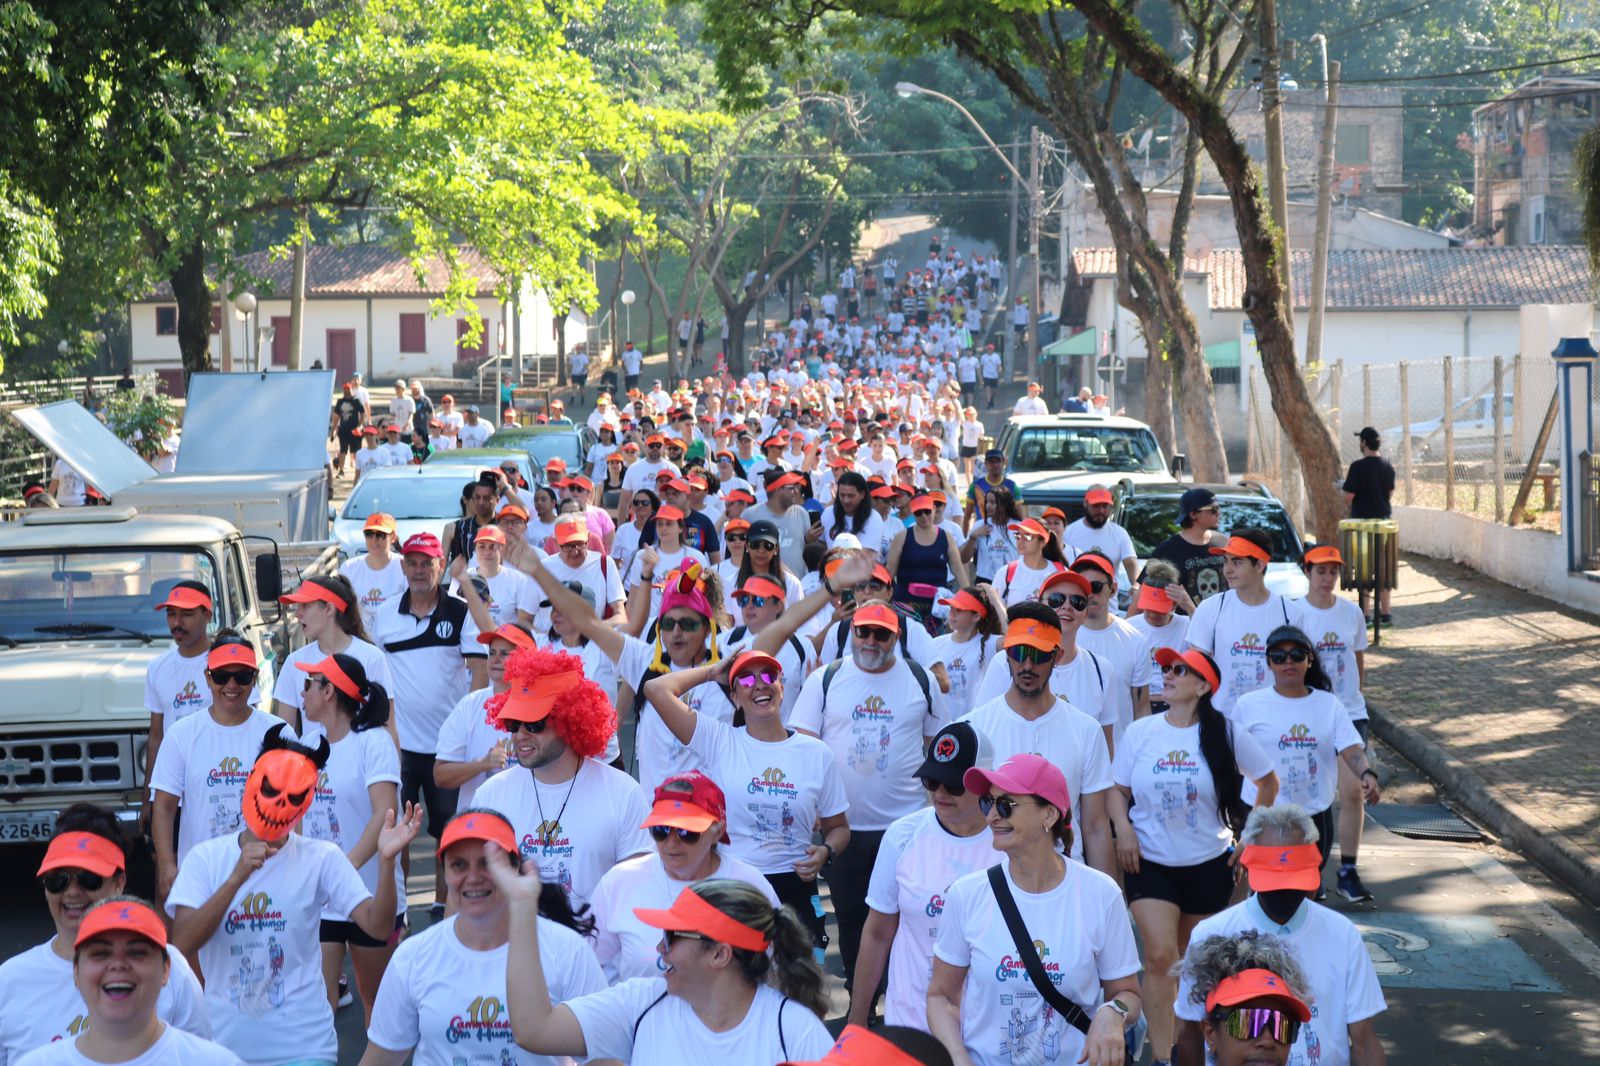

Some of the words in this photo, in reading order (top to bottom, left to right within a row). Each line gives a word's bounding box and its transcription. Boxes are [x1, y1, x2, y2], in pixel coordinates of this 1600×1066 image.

[440, 620, 452, 637] XV
[523, 834, 570, 848] Camihada
[996, 964, 1019, 982] Com
